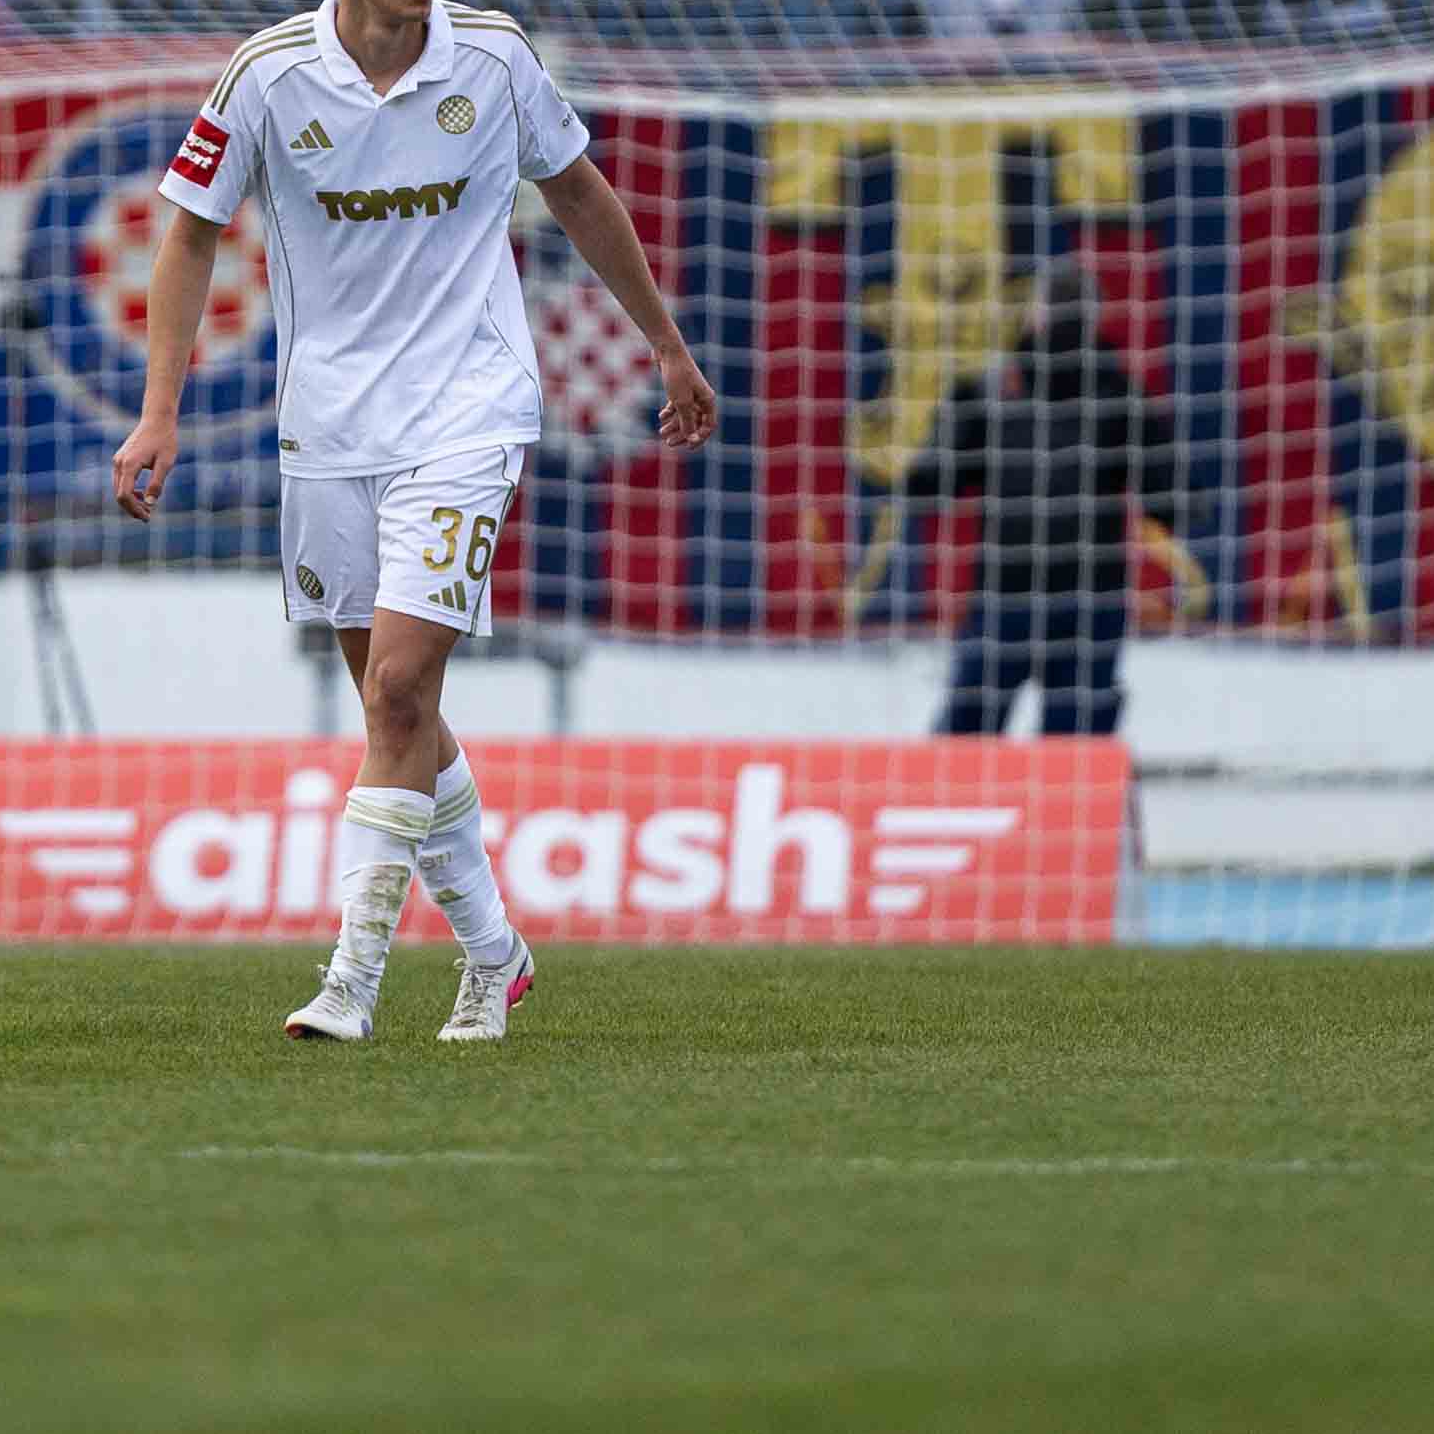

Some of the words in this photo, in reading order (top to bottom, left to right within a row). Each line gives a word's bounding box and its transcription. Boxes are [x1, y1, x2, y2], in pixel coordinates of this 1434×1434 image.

[315, 175, 471, 221] TOMMY
[422, 507, 497, 581] 36
[149, 763, 853, 914] aiash
